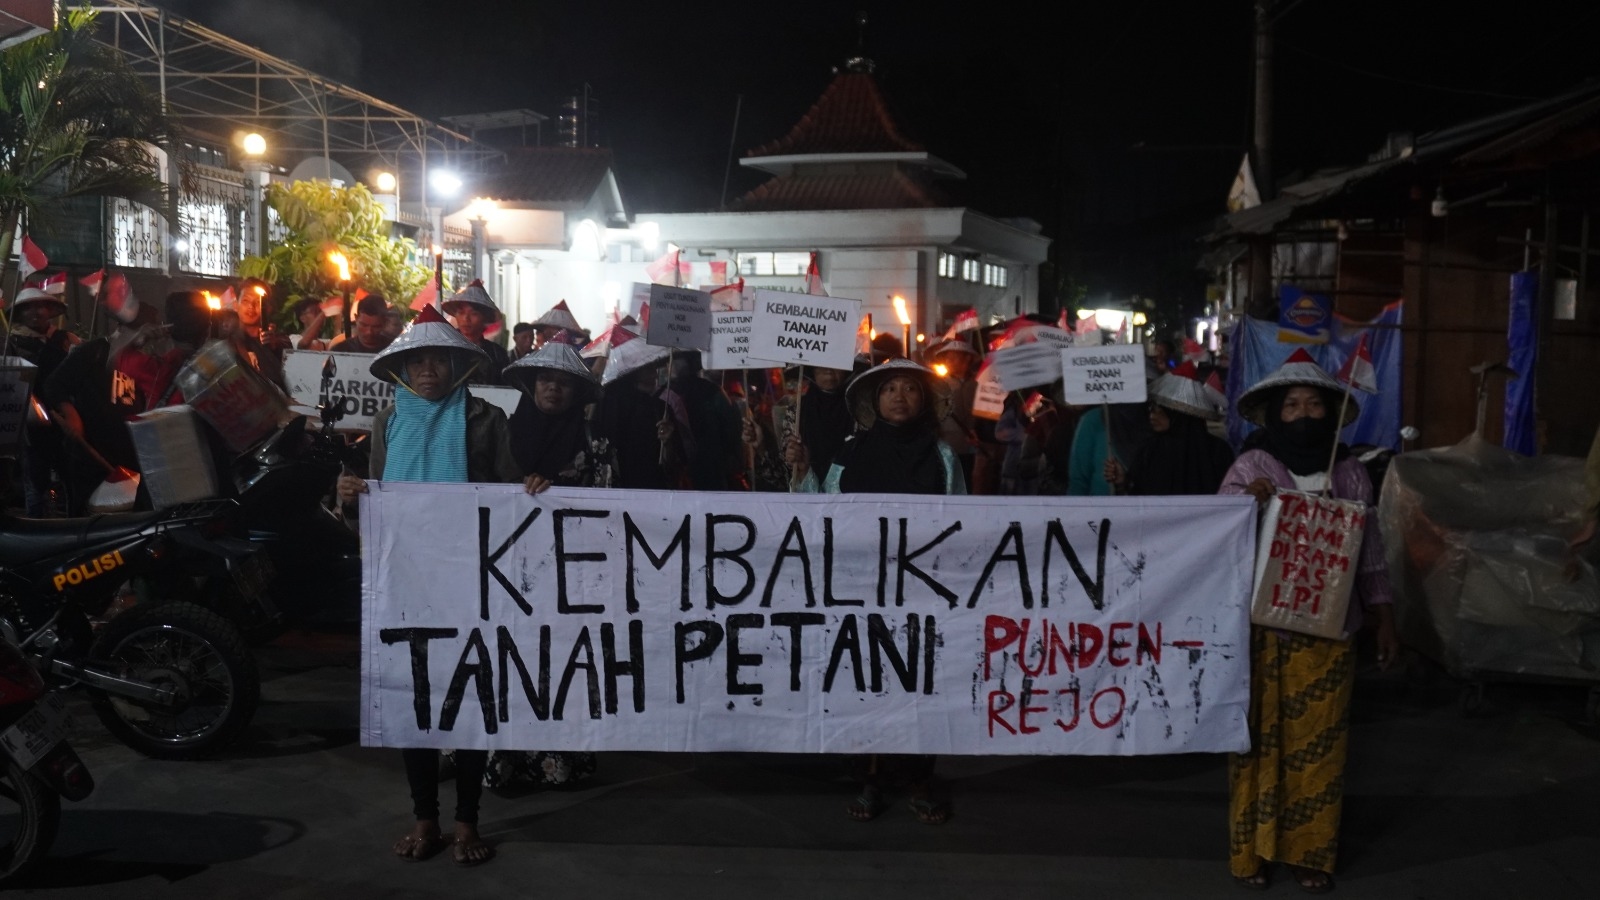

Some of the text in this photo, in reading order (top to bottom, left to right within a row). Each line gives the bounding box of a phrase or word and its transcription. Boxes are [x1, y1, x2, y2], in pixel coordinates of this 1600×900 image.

[718, 316, 735, 324] USUT
[766, 302, 847, 322] KEMBALIKAN
[783, 320, 826, 336] TANAH
[1038, 331, 1074, 344] KEMBALIKA
[777, 336, 829, 352] RAKYAT
[1072, 354, 1135, 366] KEMBALIKAN
[1087, 368, 1121, 379] TANAH
[0, 384, 15, 393] AK
[320, 379, 396, 398] PARKIR
[1085, 381, 1125, 392] RAKYAT
[0, 403, 22, 413] ARU
[318, 394, 395, 416] MOBI
[0, 423, 17, 432] KIS
[1278, 494, 1365, 530] TANAH
[1276, 518, 1344, 549] KAMI
[478, 506, 1110, 620] KEMBALIKAN
[1270, 540, 1349, 572] DIRAM
[53, 549, 125, 592] POLISI
[1282, 562, 1328, 592] PAS
[1272, 584, 1321, 615] LPI
[380, 619, 645, 734] TANAH
[675, 612, 936, 704] PETANI
[988, 687, 1126, 738] REJO
[2, 734, 18, 753] K
